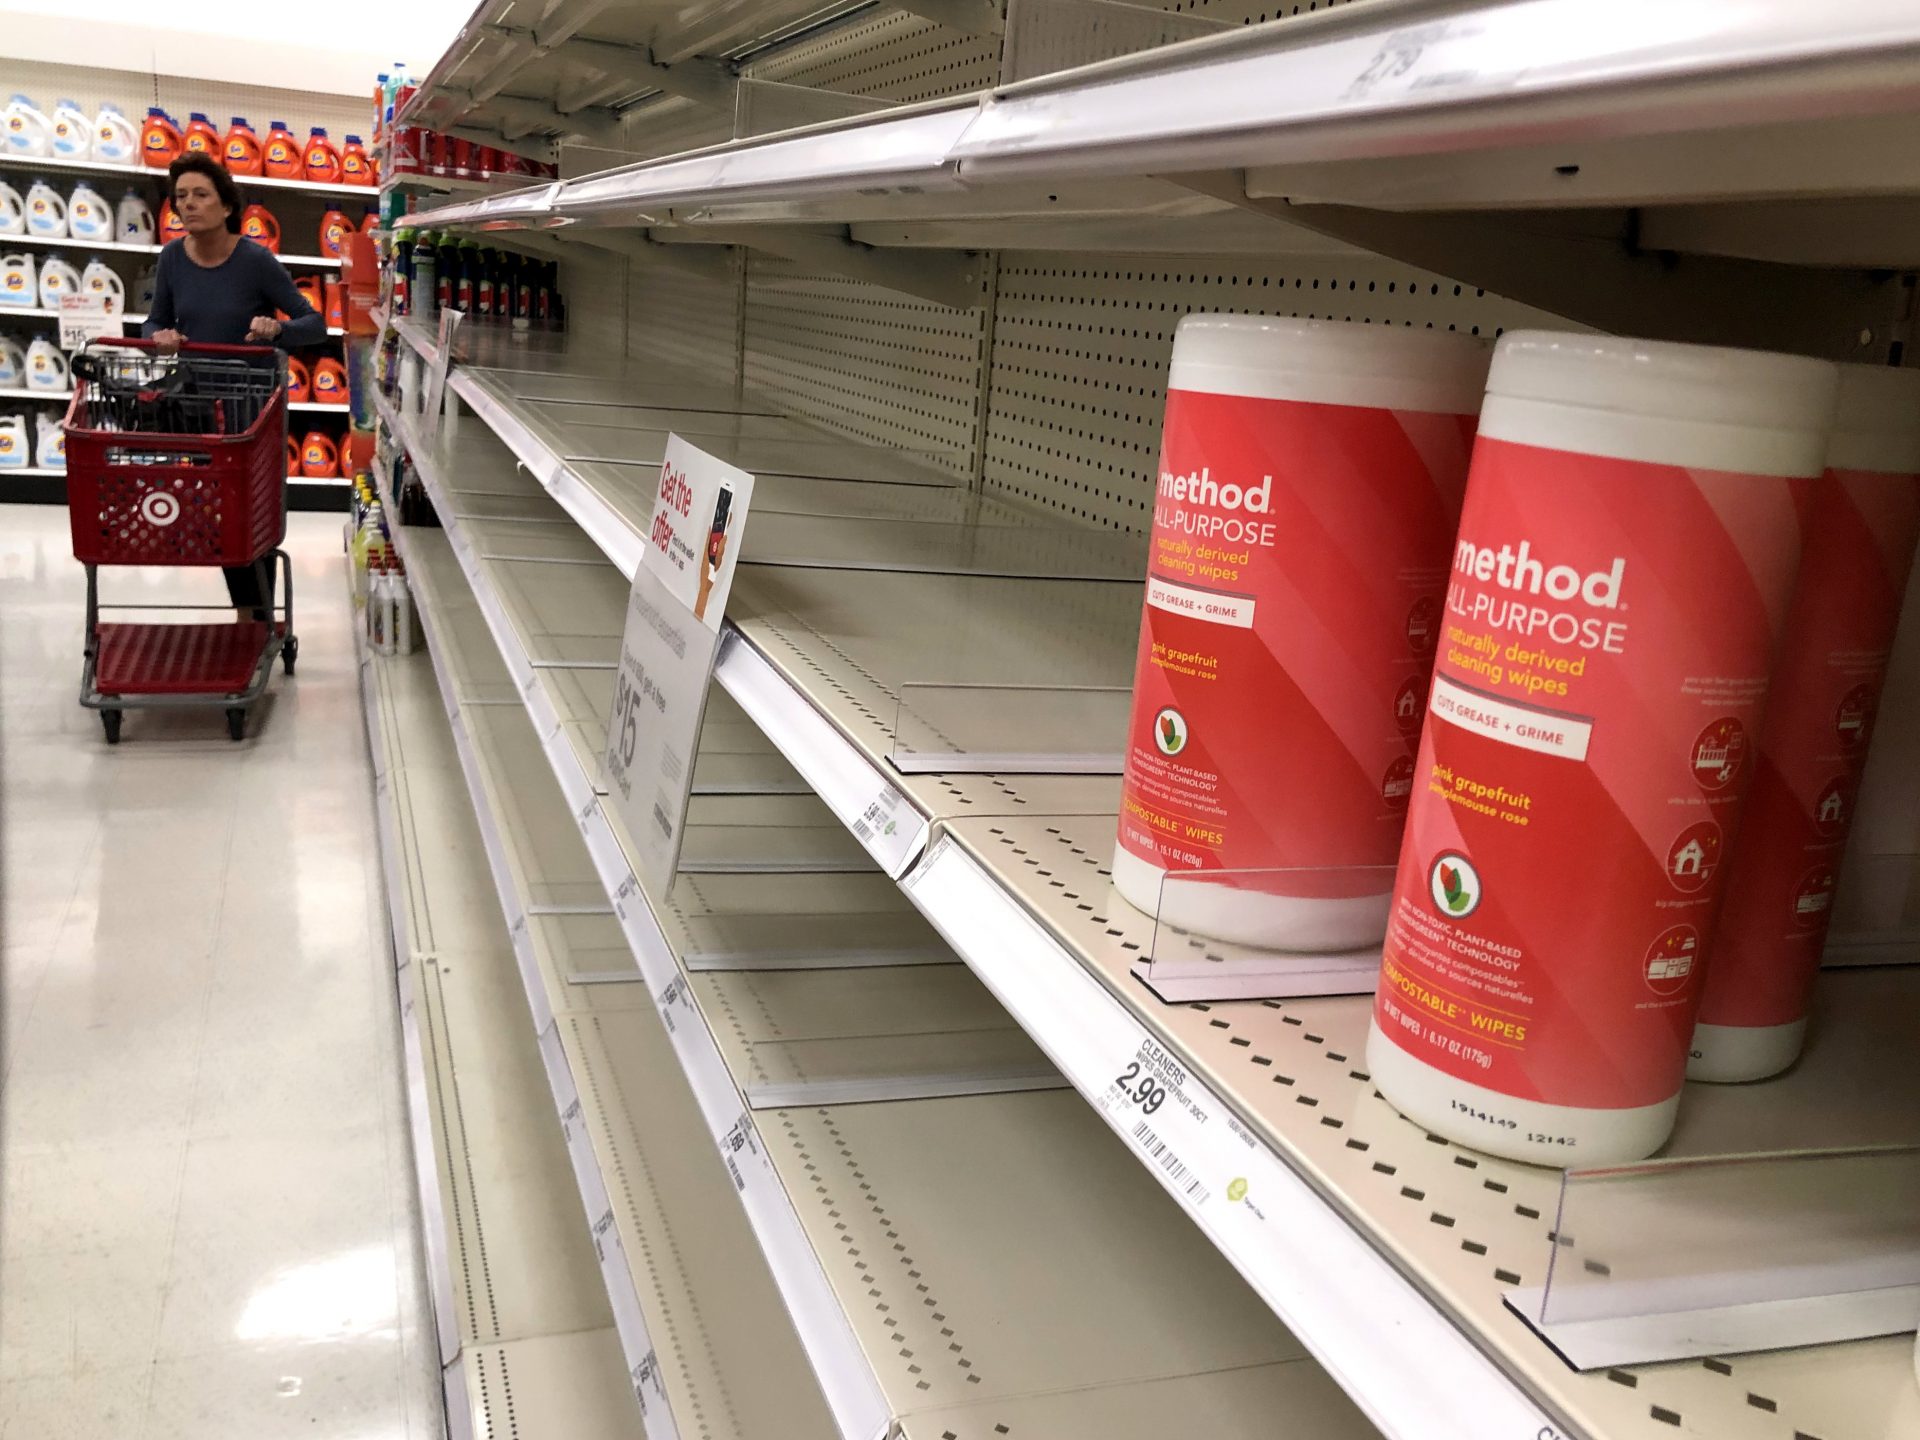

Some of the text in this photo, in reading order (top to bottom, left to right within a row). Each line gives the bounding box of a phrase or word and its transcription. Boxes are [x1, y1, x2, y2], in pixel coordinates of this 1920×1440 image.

[65, 328, 87, 342] $15
[660, 461, 692, 518] Get the
[1160, 467, 1272, 513] method
[651, 510, 674, 554] offer
[1157, 537, 1249, 565] naturally derived
[1158, 553, 1238, 581] cleaning wipes
[1455, 539, 1626, 609] method
[1166, 594, 1194, 610] GREASE
[1205, 604, 1237, 618] GRIME
[1151, 641, 1218, 668] pink grapefruit
[1447, 625, 1586, 677] naturally derived
[1198, 669, 1217, 680] rose
[1447, 647, 1568, 696] cleaning wipes
[616, 672, 641, 768] $15
[1437, 694, 1455, 713] CUTS
[1456, 704, 1500, 729] GREASE
[1516, 724, 1565, 746] GRIME
[1167, 771, 1217, 792] TECHNOLOGY
[1431, 763, 1532, 810] pink grapefruit
[1500, 810, 1529, 826] rose
[1185, 825, 1224, 845] WIPES
[1446, 939, 1521, 972] TECHNOLOGY
[1455, 929, 1522, 959] PLANT-BASED
[1484, 983, 1534, 1004] naturelles
[1471, 1011, 1527, 1041] WIPES
[1141, 1038, 1187, 1086] CLEANERS
[1448, 1039, 1461, 1056] OZ
[1462, 1046, 1493, 1069] (175g)
[1115, 1061, 1166, 1115] 2.99
[1135, 1049, 1154, 1073] WIPES
[1153, 1068, 1192, 1108] GRAPEFRUIT
[1451, 1099, 1518, 1129] 1914149
